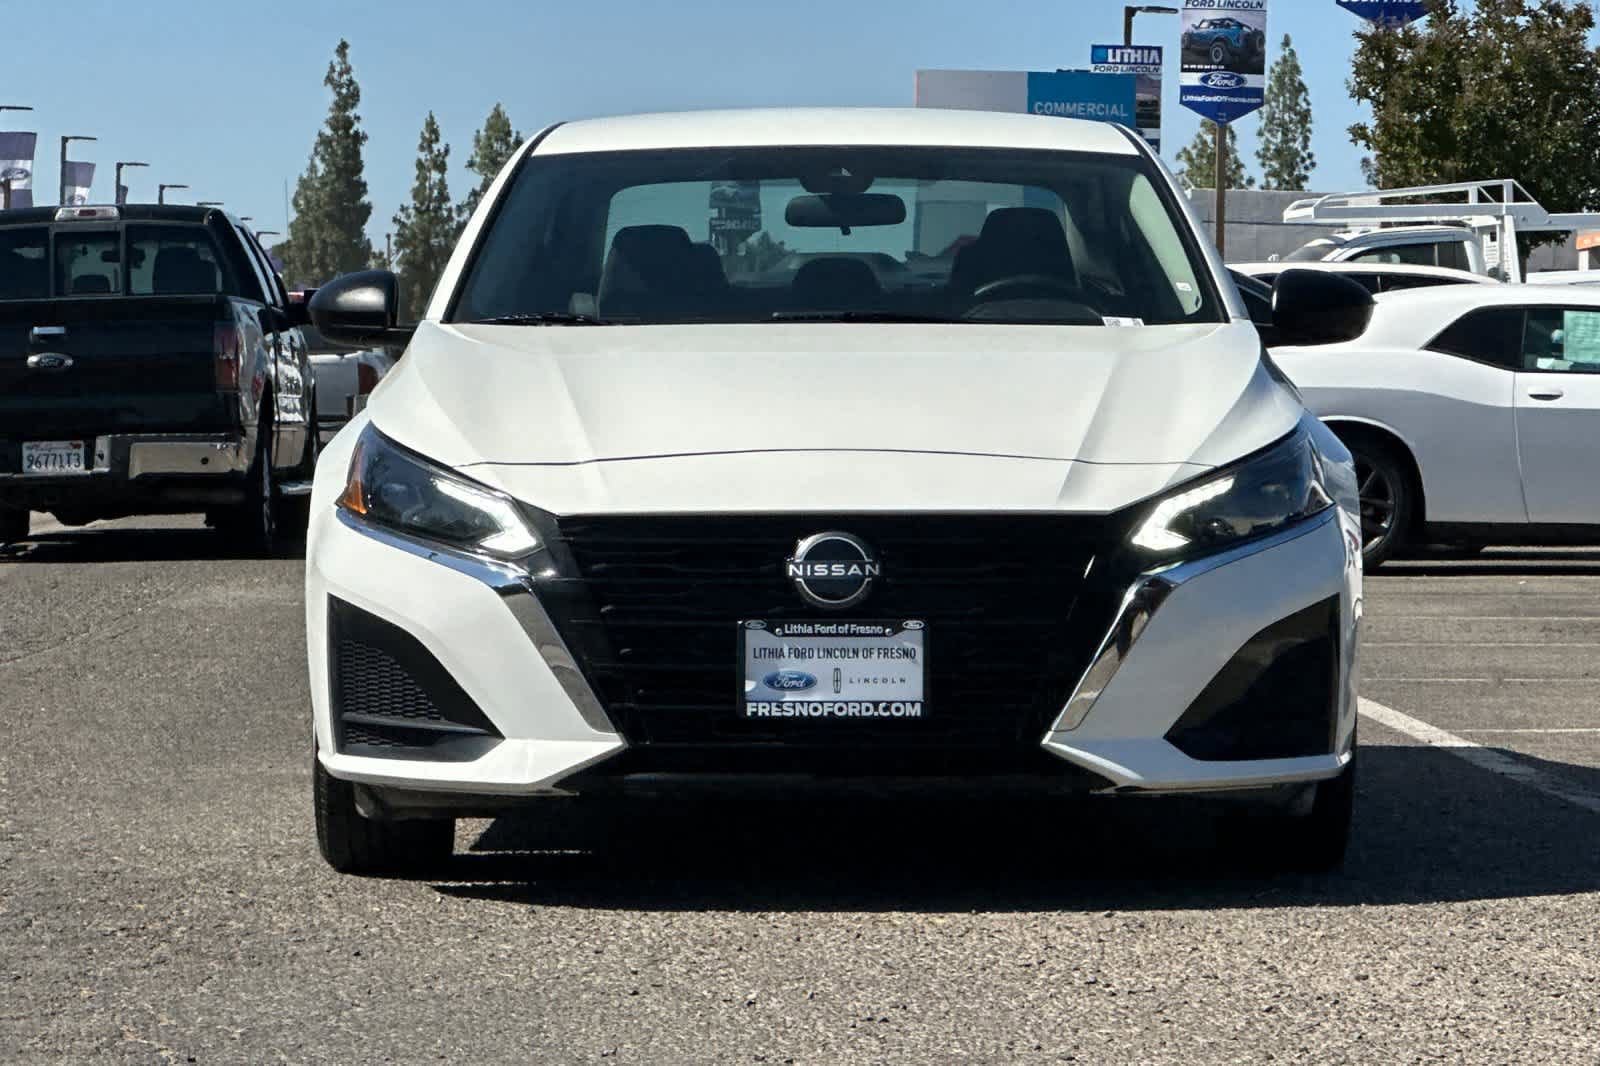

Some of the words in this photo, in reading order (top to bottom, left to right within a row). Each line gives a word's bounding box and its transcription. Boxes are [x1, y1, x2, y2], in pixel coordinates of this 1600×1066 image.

[1186, 0, 1215, 8] FORD
[1217, 0, 1264, 9] LINCOLN
[1107, 48, 1160, 63] LITHIA
[1094, 65, 1119, 73] FORD
[1121, 65, 1160, 73] LINCOLN
[1034, 101, 1129, 117] COMMERCIAL
[788, 563, 880, 577] NISSAN
[784, 624, 813, 635] Lithia
[814, 624, 837, 635] Ford
[838, 624, 849, 635] of
[850, 624, 884, 635] Fresno
[753, 647, 785, 660] LITHIA
[788, 647, 815, 660] FORD
[817, 647, 860, 660] LINCOLN
[862, 647, 875, 660] OF
[877, 647, 917, 660] FRESNO
[773, 673, 807, 688] Ford
[746, 702, 921, 717] FRESNOFORD.COM
